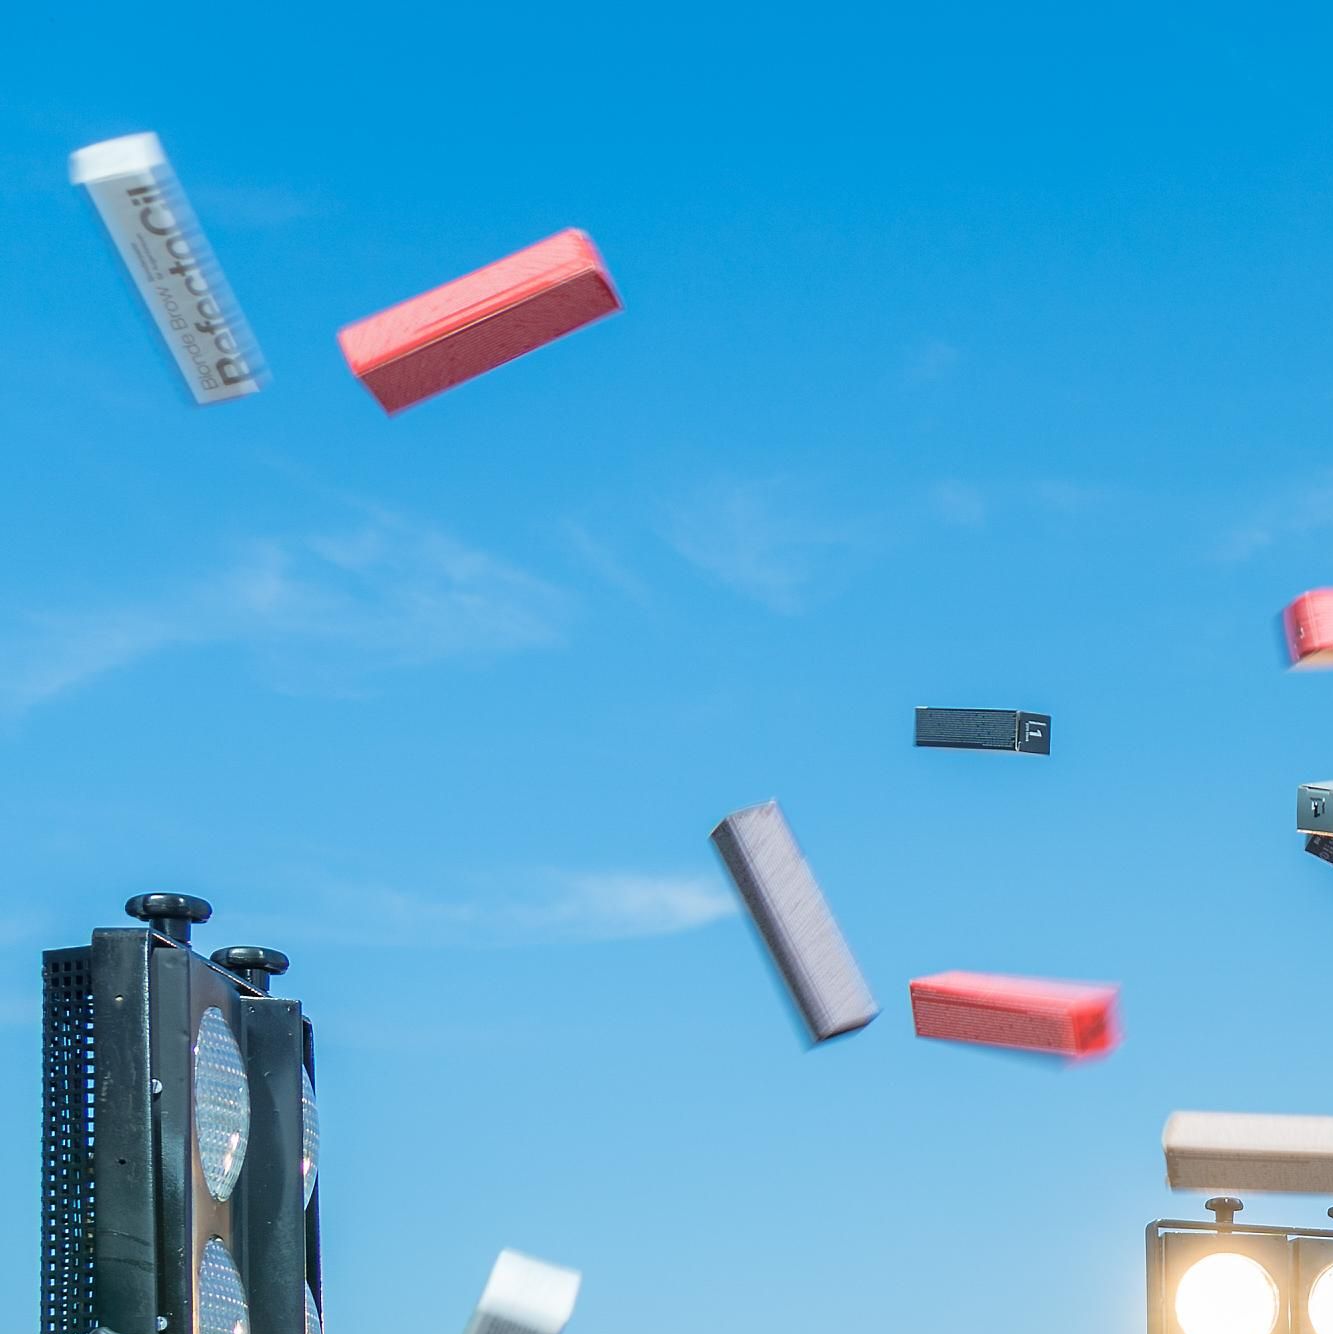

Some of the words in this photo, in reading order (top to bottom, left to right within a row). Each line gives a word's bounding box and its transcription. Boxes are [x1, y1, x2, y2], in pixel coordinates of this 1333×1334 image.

[126, 186, 254, 387] RefectoCil
[155, 286, 188, 332] Brow
[182, 333, 218, 392] Blonde
